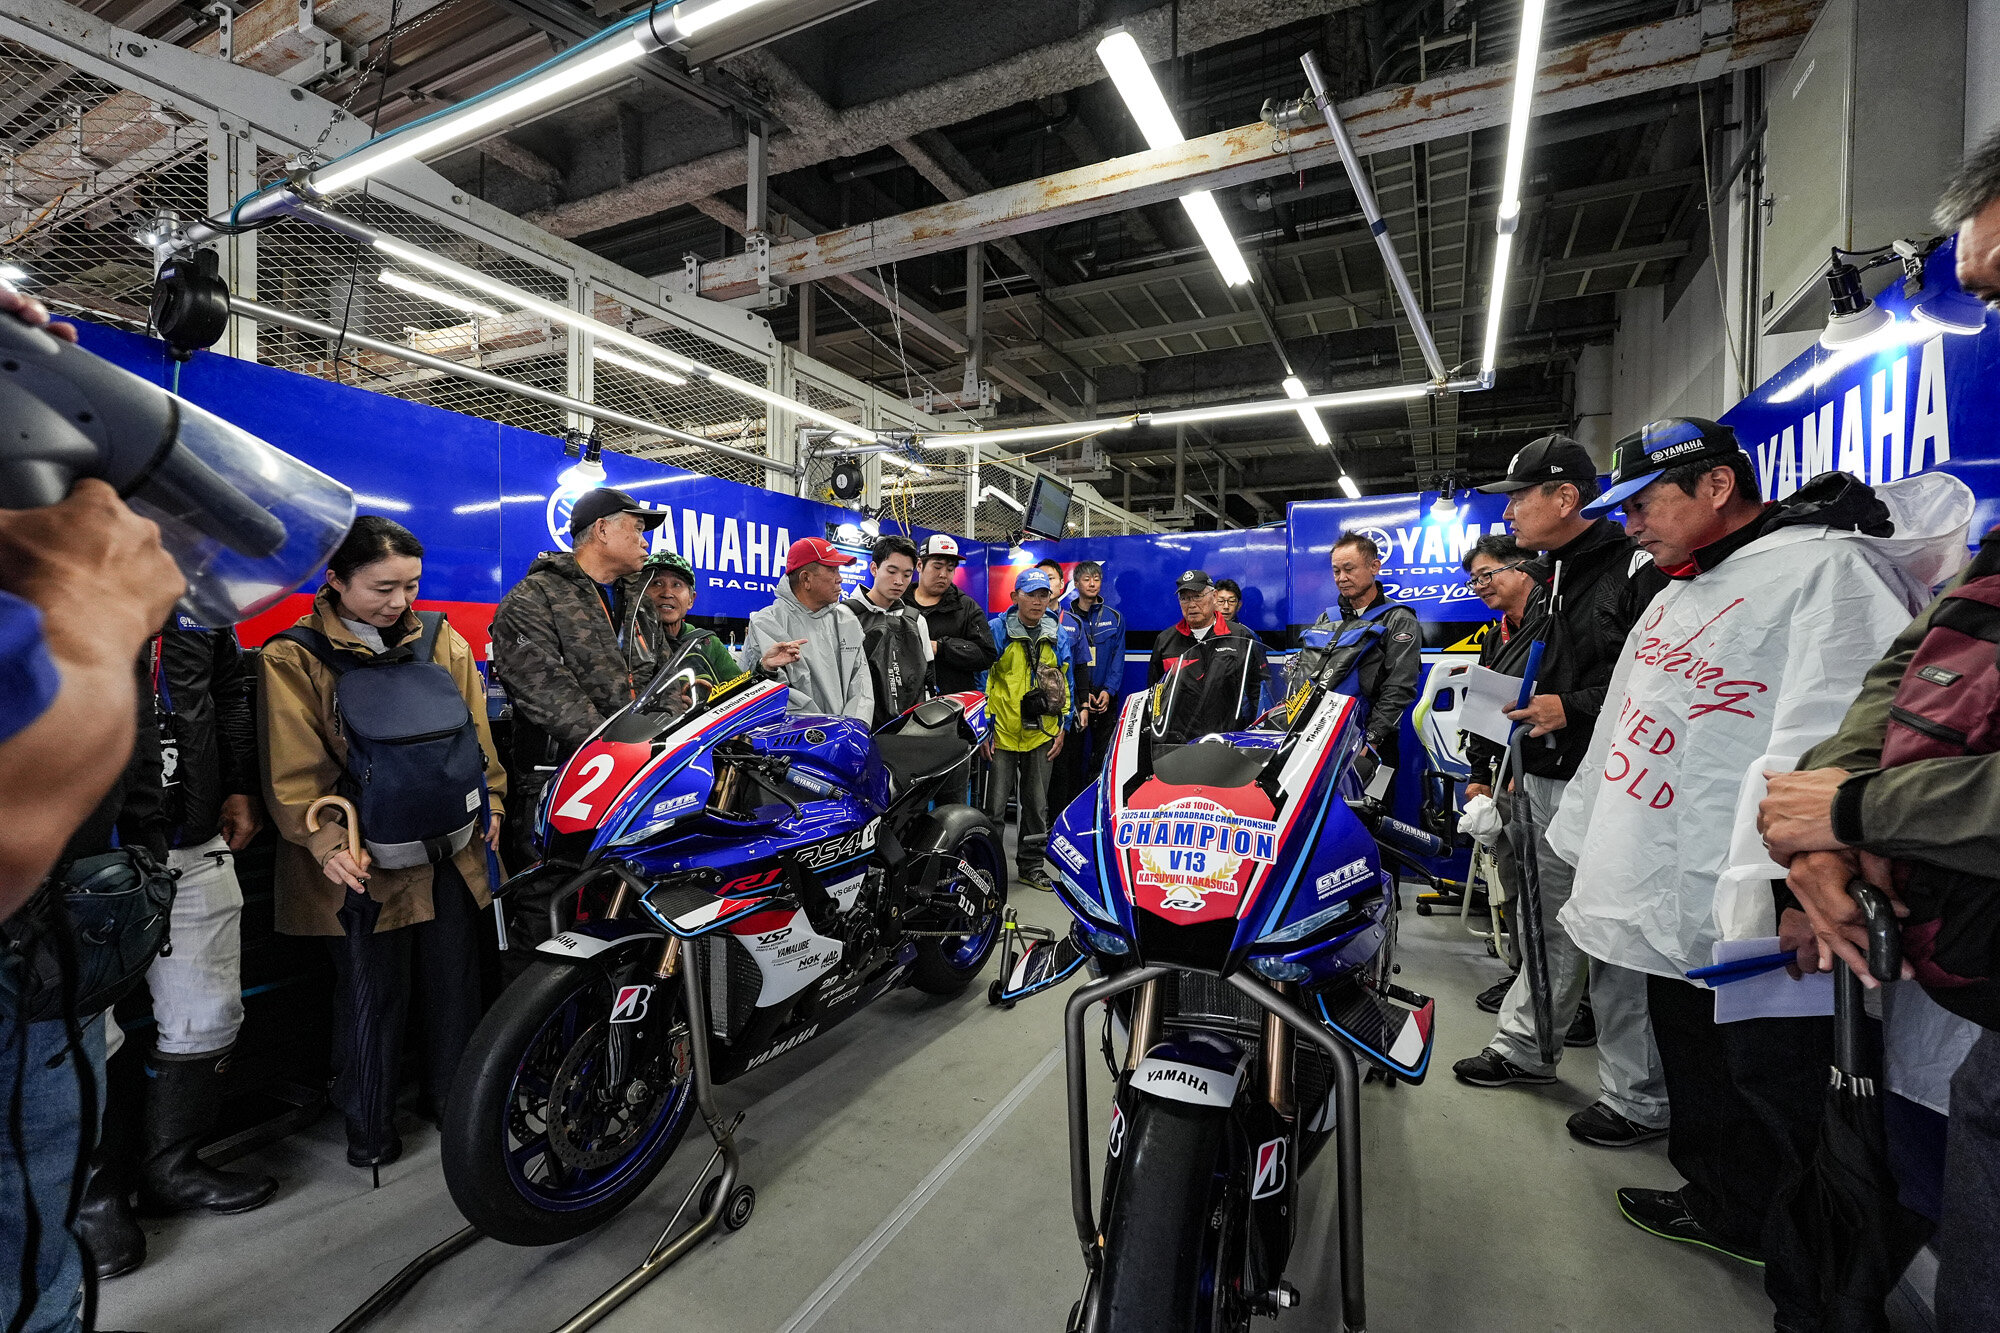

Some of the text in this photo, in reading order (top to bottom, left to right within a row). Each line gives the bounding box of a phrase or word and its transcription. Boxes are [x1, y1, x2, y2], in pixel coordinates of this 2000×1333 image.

[1757, 333, 1950, 502] YAMAHA
[1662, 438, 1704, 458] YAMAHA
[638, 500, 791, 578] AMAHA
[1396, 522, 1508, 565] YAM
[1378, 566, 1461, 576] CTORY
[709, 577, 779, 593] RACIN
[887, 668, 898, 698] STREET
[892, 661, 903, 687] KEY OF
[713, 684, 767, 716] Titanium Power
[1130, 696, 1144, 719] Titanium
[1306, 715, 1327, 743] Titanium
[1618, 692, 1676, 756] RIED
[554, 753, 615, 821] 2
[800, 777, 821, 793] YAMAHA
[1604, 743, 1675, 810] OLD
[653, 791, 700, 814] GYTR
[1193, 801, 1215, 811] 1000
[1120, 811, 1277, 832] 2025 ALL JAPAN ROADRACE CHAMPIONSHIP
[1401, 823, 1431, 841] YAMAHA
[1117, 821, 1275, 861] CHAMPION
[1169, 850, 1206, 873] V13
[1316, 857, 1369, 892] GYTR
[715, 868, 783, 895] R1
[832, 881, 861, 898] Y'S GEAR
[1138, 872, 1236, 893] KATSUYUKI NAKASUGA
[1318, 871, 1375, 901] PERFORMANCE PRODUCTS
[757, 928, 793, 945] YSP
[777, 939, 811, 958] YAMALUBE
[798, 953, 822, 968] NGK
[744, 1023, 820, 1072] YAMAHA
[1147, 1069, 1209, 1096] YAMAHA
